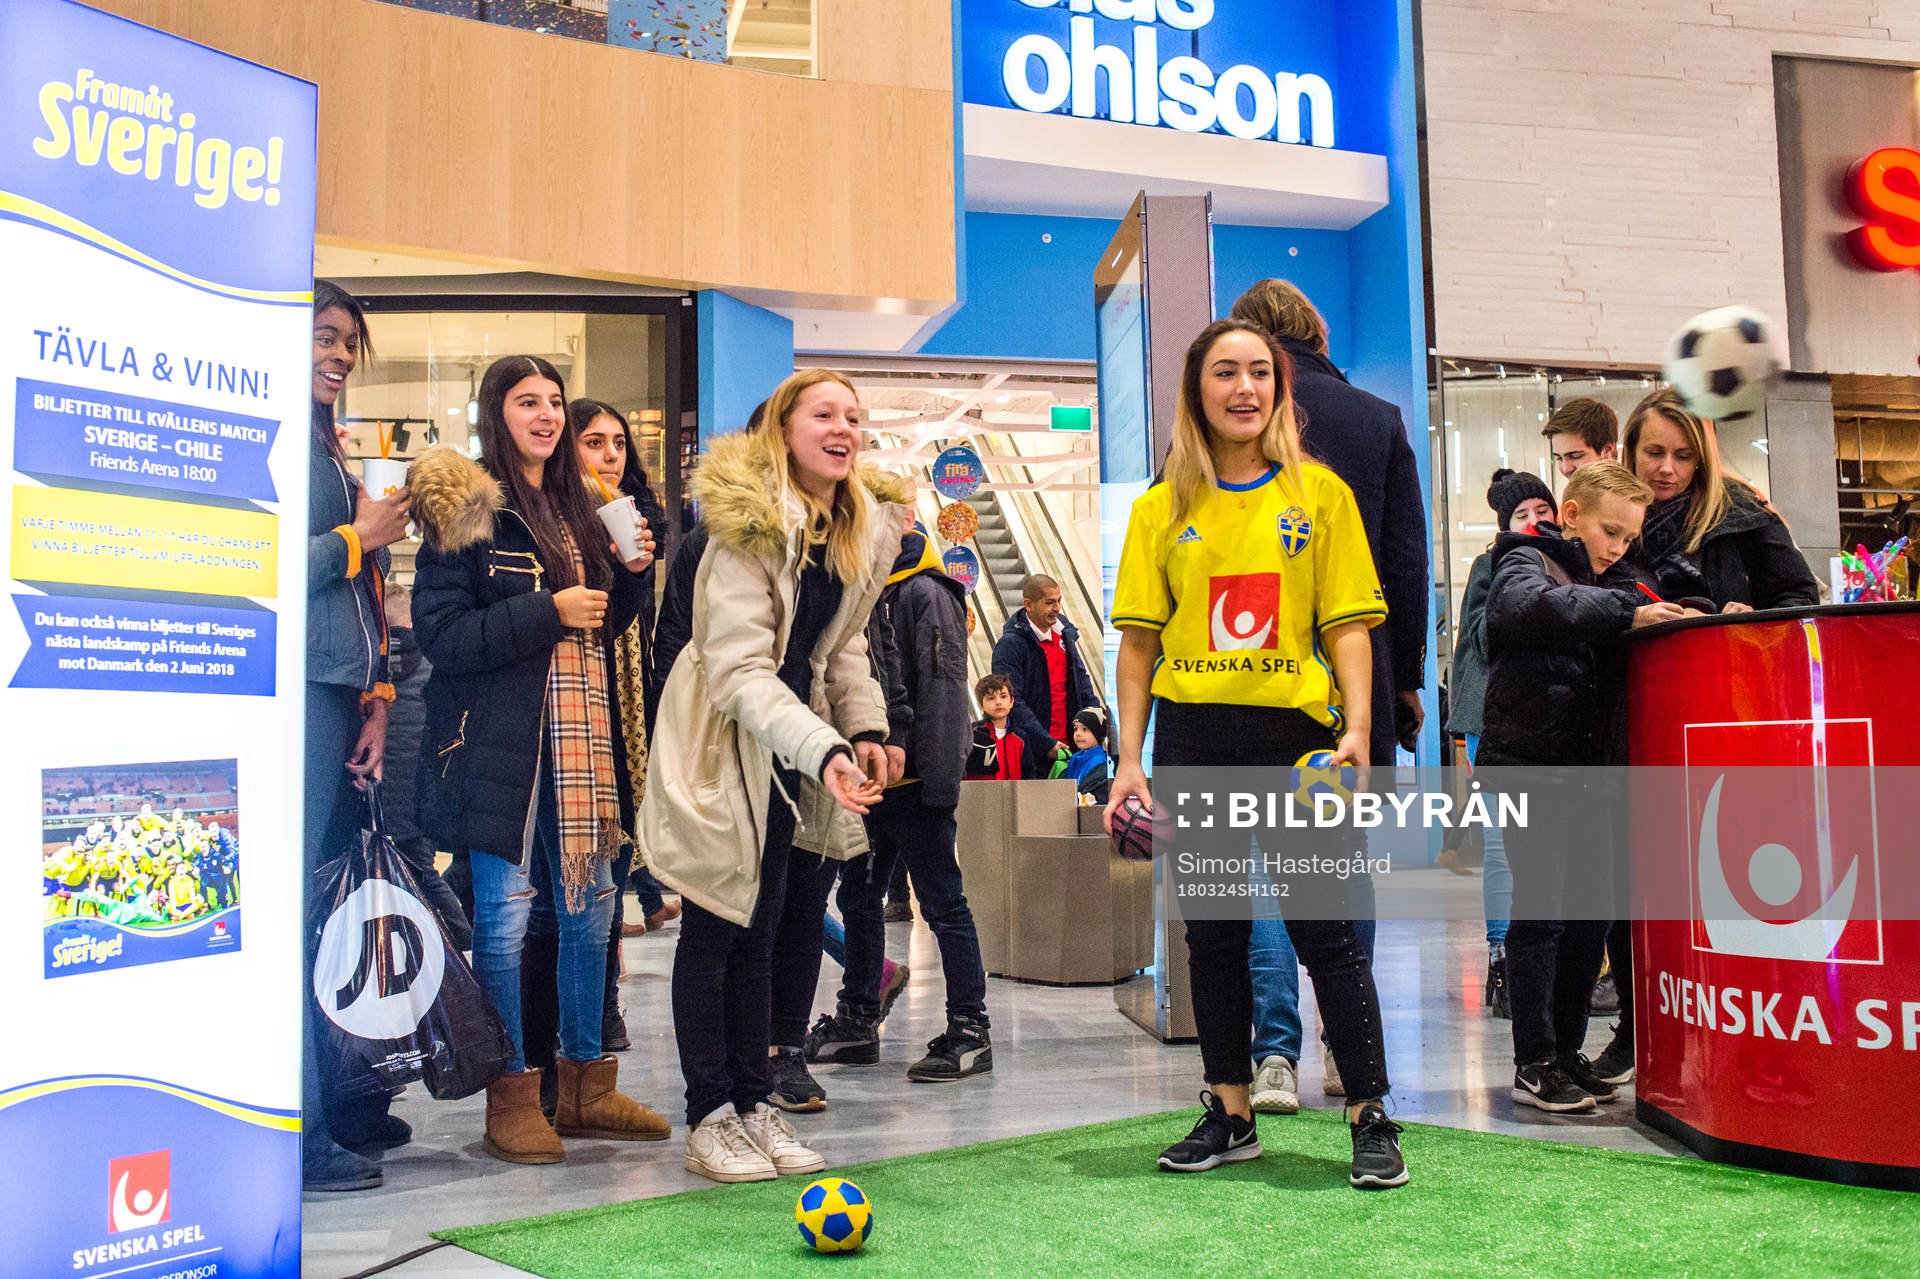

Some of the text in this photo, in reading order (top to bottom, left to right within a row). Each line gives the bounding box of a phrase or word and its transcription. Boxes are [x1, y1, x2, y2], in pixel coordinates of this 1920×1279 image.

[75, 68, 174, 123] Framåt
[1003, 16, 1335, 149] ohlson
[33, 81, 284, 209] Sverige!
[33, 326, 269, 400] TÄVLA & VINN!
[33, 393, 267, 444] BILJETTER TILL KVÄLLENS MATCH
[84, 425, 159, 453] SVERIGE
[174, 438, 223, 462] CHILE
[90, 450, 217, 483] Friends Arena 18:00
[21, 517, 56, 530] VARJE
[58, 519, 95, 534] TIMME
[98, 523, 142, 538] MELLAN
[178, 532, 200, 544] HAR
[202, 534, 216, 547] DU
[219, 536, 253, 551] CHANS
[255, 541, 272, 553] ATT
[31, 539, 68, 552] VINNA
[71, 541, 127, 557] BILJETTER
[35, 612, 257, 641] Du kan också vinna biljetter till Sveriges
[45, 633, 247, 657] nästa landskamp på Friends Arena
[58, 656, 235, 676] mot Danmark den 2 Juni 2018
[1171, 656, 1254, 674] SVENSKA
[51, 933, 123, 968] Sverige!
[336, 913, 425, 1012] JD
[1658, 970, 1833, 1046] SVENSKA
[72, 1224, 205, 1270] SVENSKA SPEL
